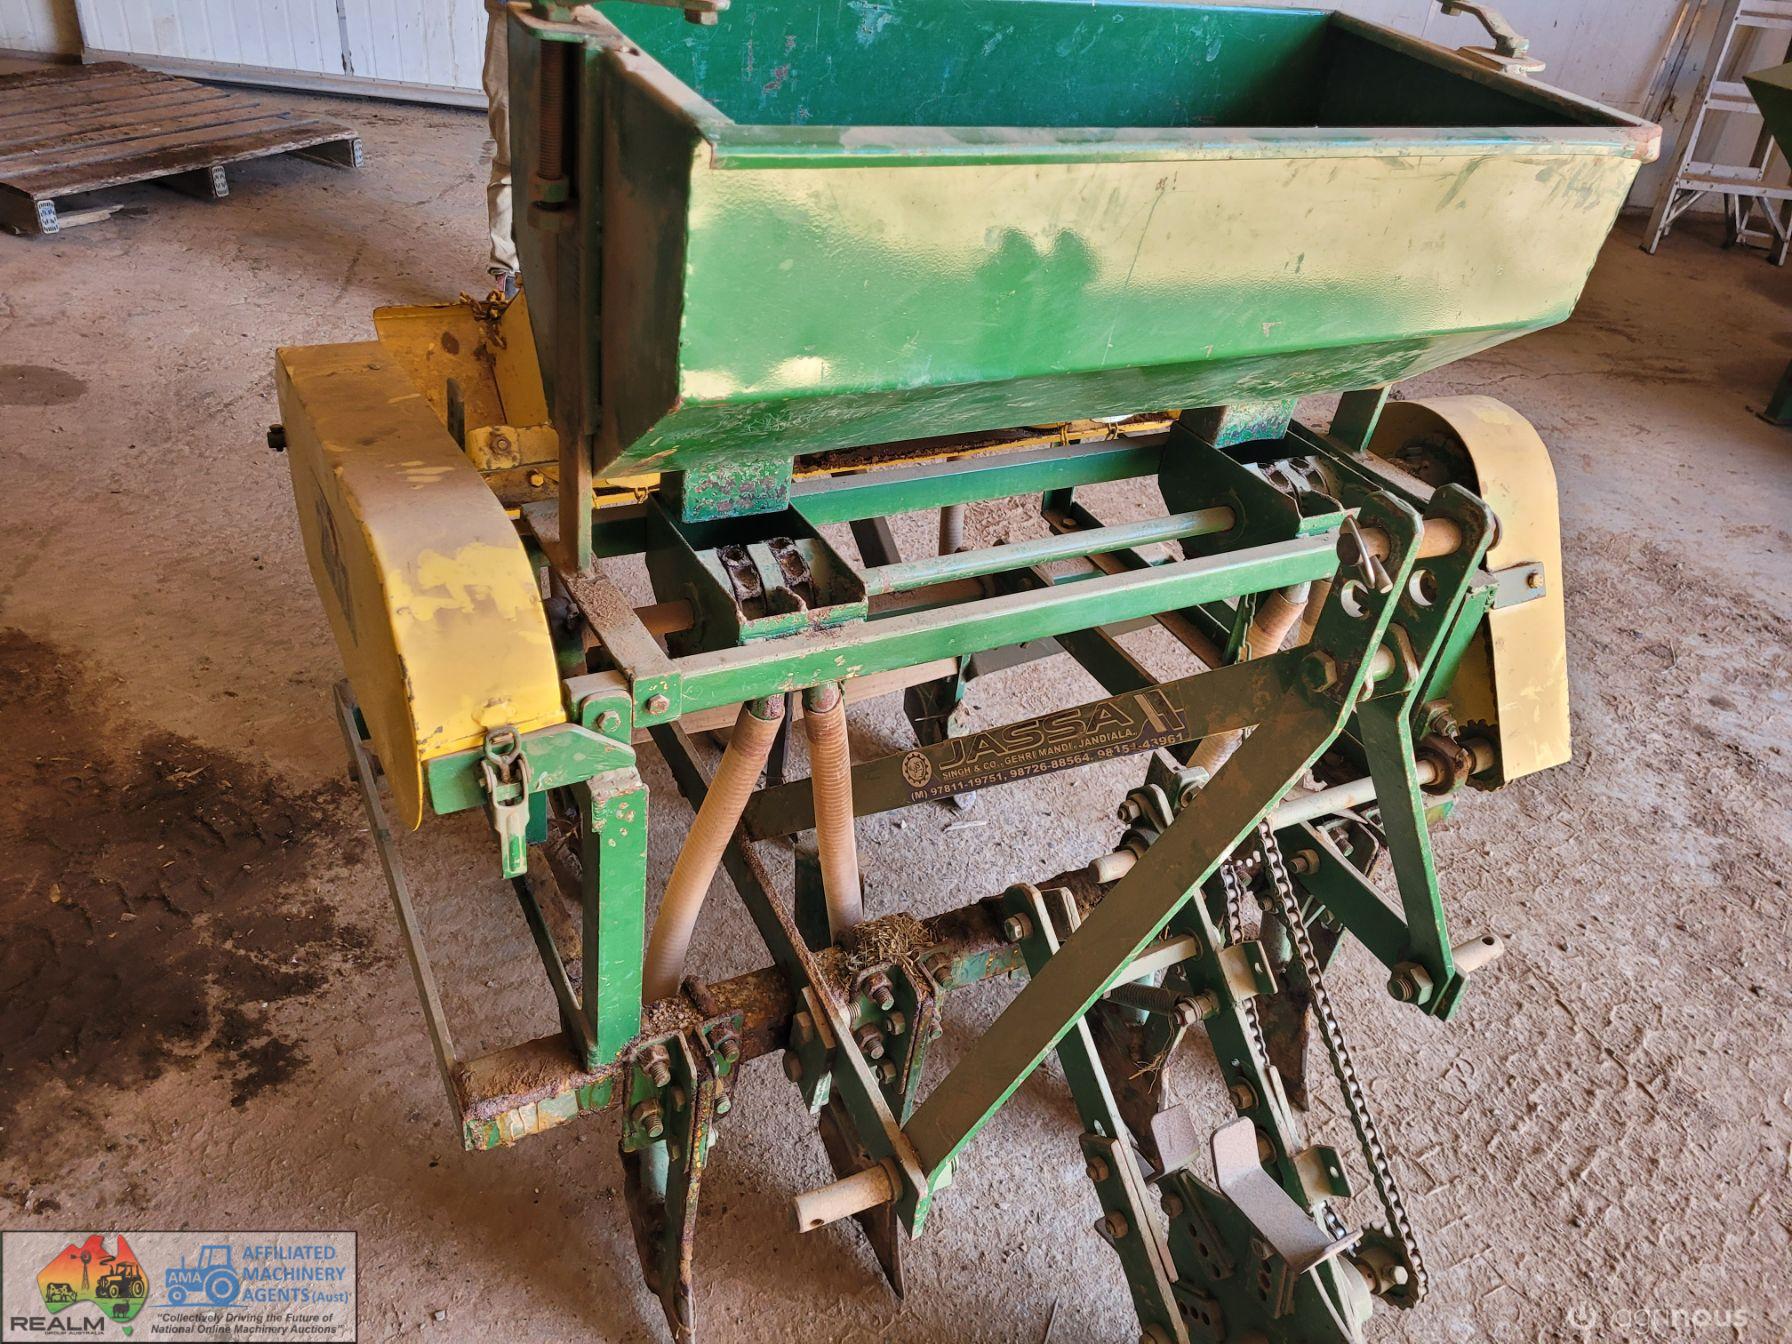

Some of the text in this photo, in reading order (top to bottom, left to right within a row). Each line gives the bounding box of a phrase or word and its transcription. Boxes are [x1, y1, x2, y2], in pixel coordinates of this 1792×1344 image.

[942, 766, 972, 780] SINGH
[974, 765, 984, 773] &
[1005, 752, 1037, 765] GEHRI
[911, 790, 928, 801] (M)
